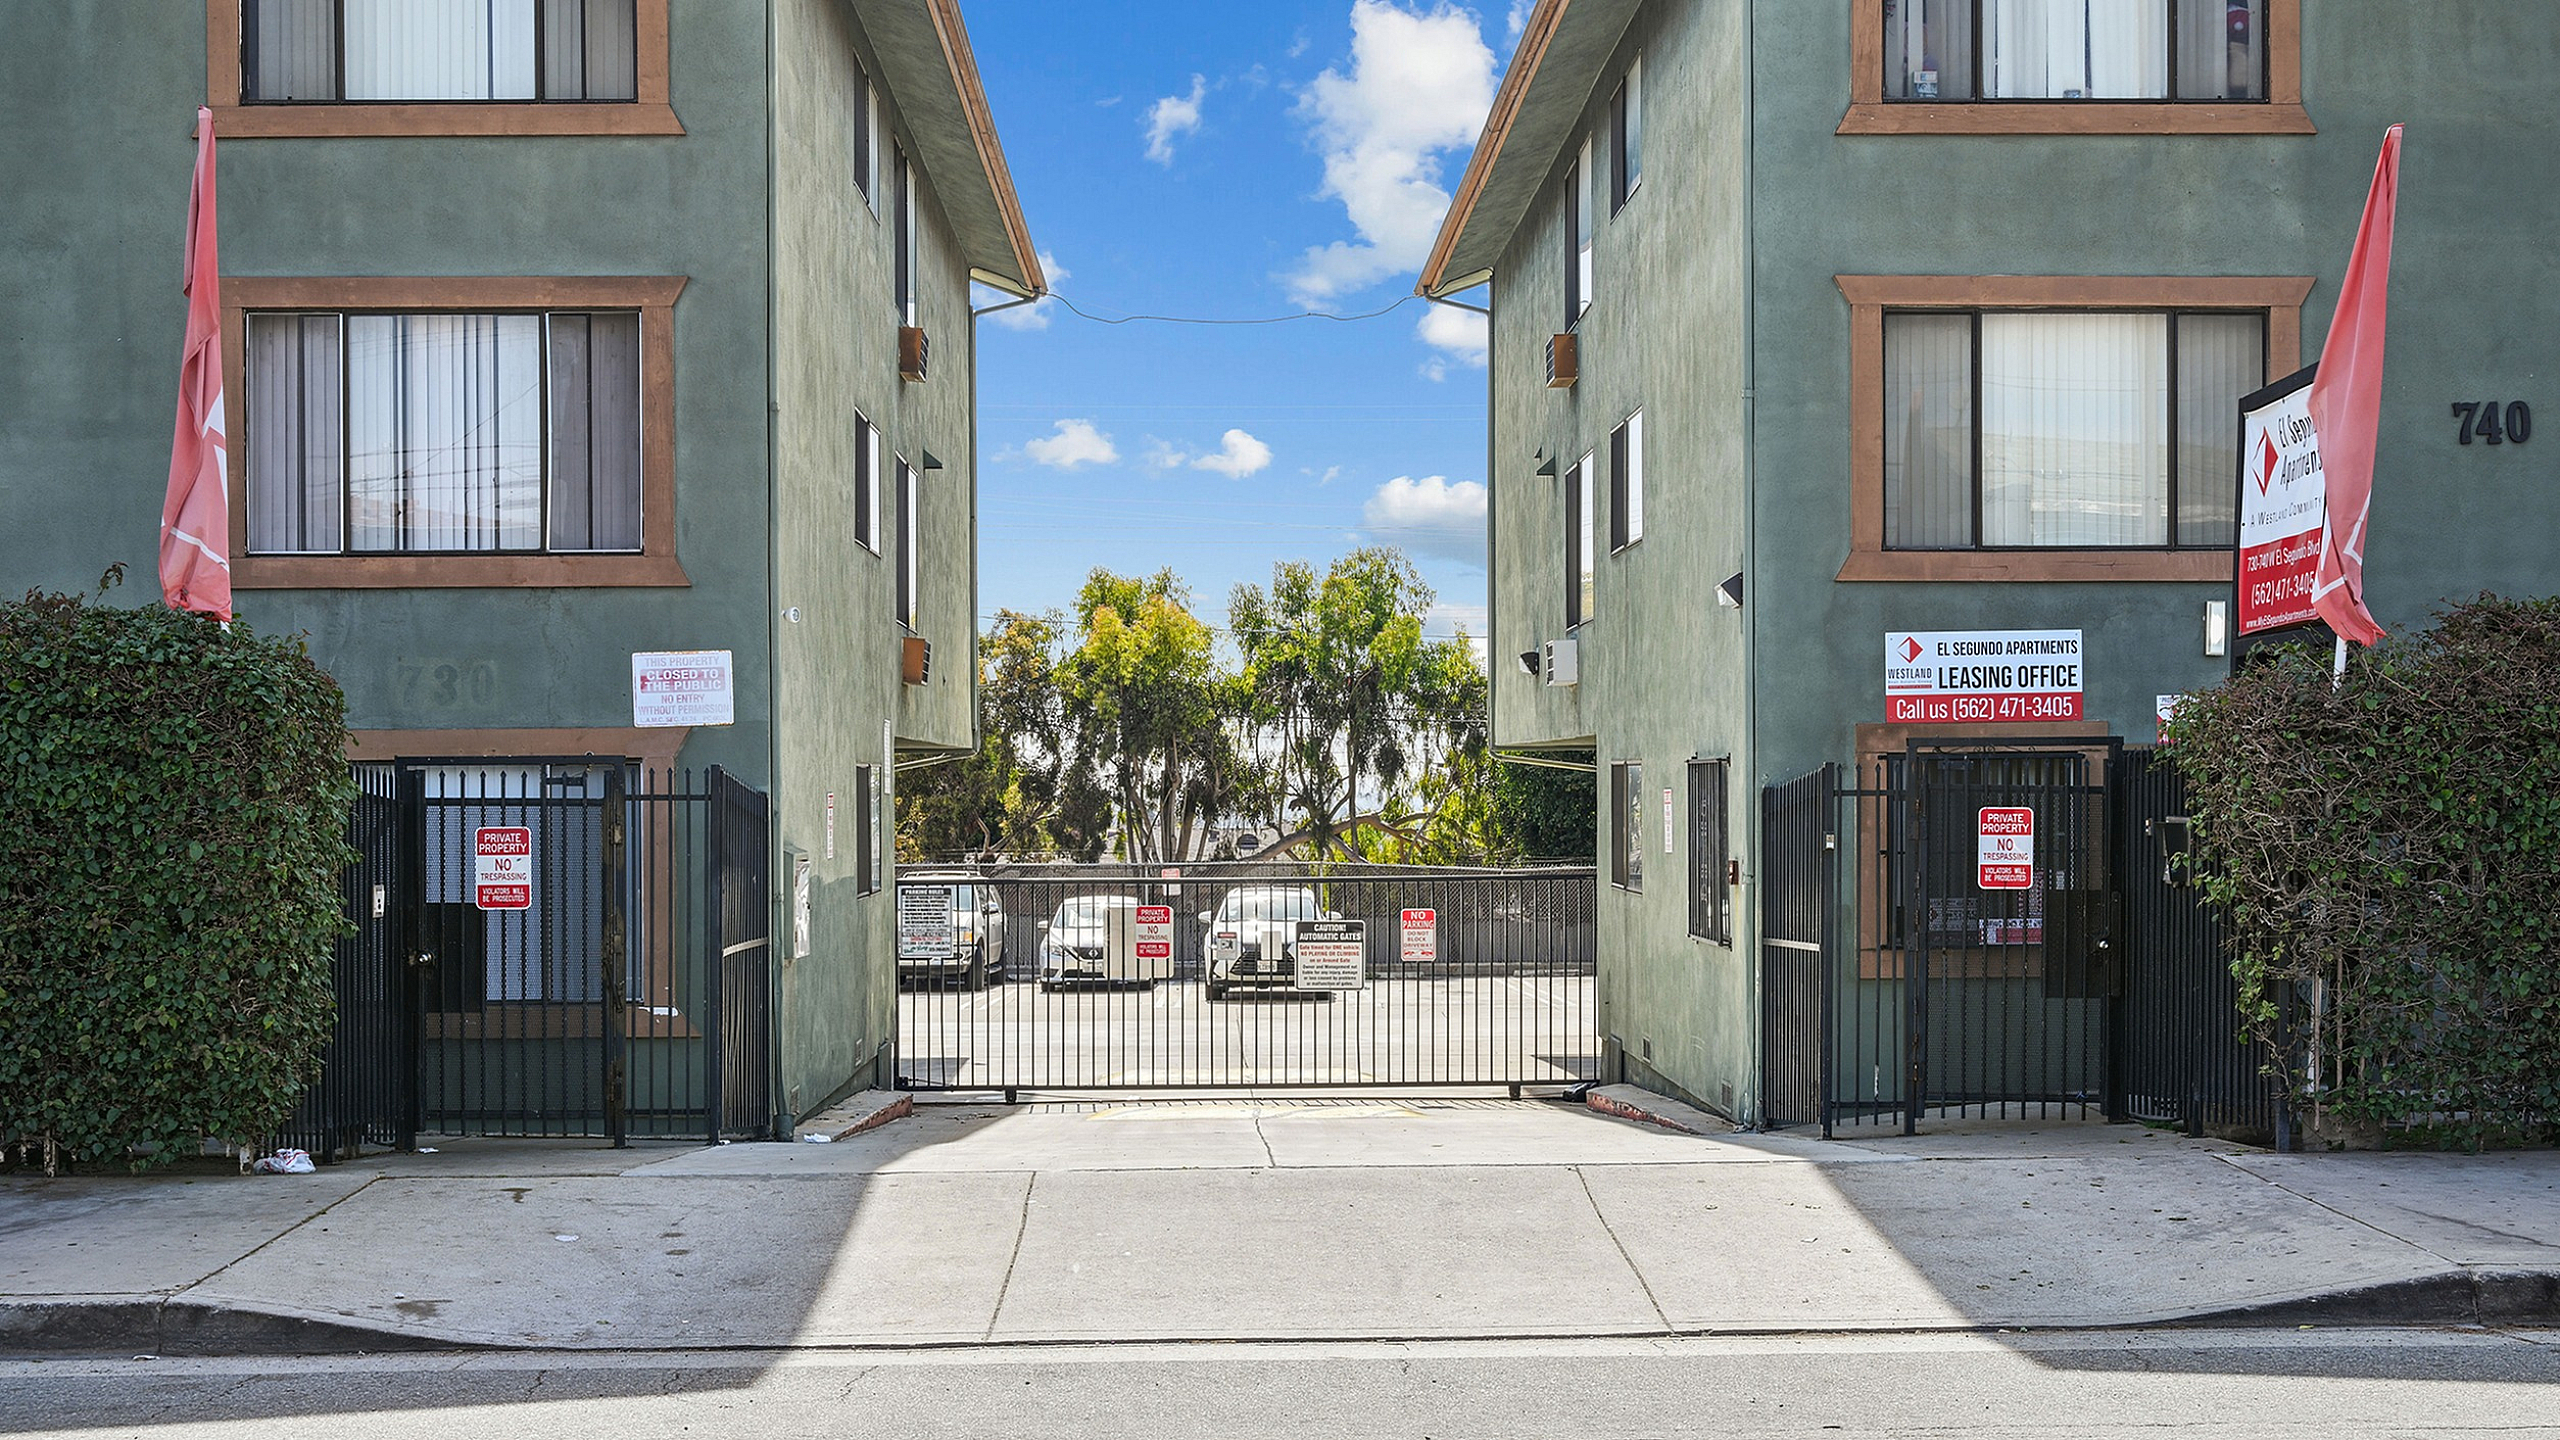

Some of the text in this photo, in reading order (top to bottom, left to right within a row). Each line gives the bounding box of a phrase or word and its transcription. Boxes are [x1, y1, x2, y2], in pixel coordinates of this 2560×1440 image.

[2451, 401, 2531, 445] 740
[2278, 417, 2289, 448] El
[2247, 553, 2269, 572] 730-740
[1937, 640, 2078, 656] EL SEGUNDO APARTMENTS
[644, 656, 719, 667] THIS PROPERTY
[647, 668, 719, 681] CLOSED TO
[1888, 667, 1932, 680] WESTLAND
[1938, 665, 2078, 689] LEASING OFFICE
[400, 664, 495, 707] 730
[645, 679, 721, 692] THE PUBLIC
[661, 694, 705, 704] NO ENTRY
[638, 703, 729, 716] WITHOUT PERMISSION
[1896, 696, 2073, 720] Call us (562) 471-3405
[1987, 813, 2024, 823] PRIVATE
[1982, 823, 2030, 833] PROPERTY
[484, 833, 522, 843] PRIVATE
[479, 843, 527, 853] PROPERTY
[1997, 838, 2014, 851] NO
[1983, 852, 2029, 861] TRESPASSING
[495, 858, 512, 871] NO
[1984, 867, 2012, 875] VIOLATORS
[481, 872, 527, 881] TRESPASSING
[482, 887, 510, 895] VIOLATORS
[482, 895, 490, 903] BE
[1141, 909, 1164, 917] PRIVATE
[1410, 911, 1426, 920] NO
[1403, 920, 1434, 928] PARKING
[1147, 925, 1158, 934] NO
